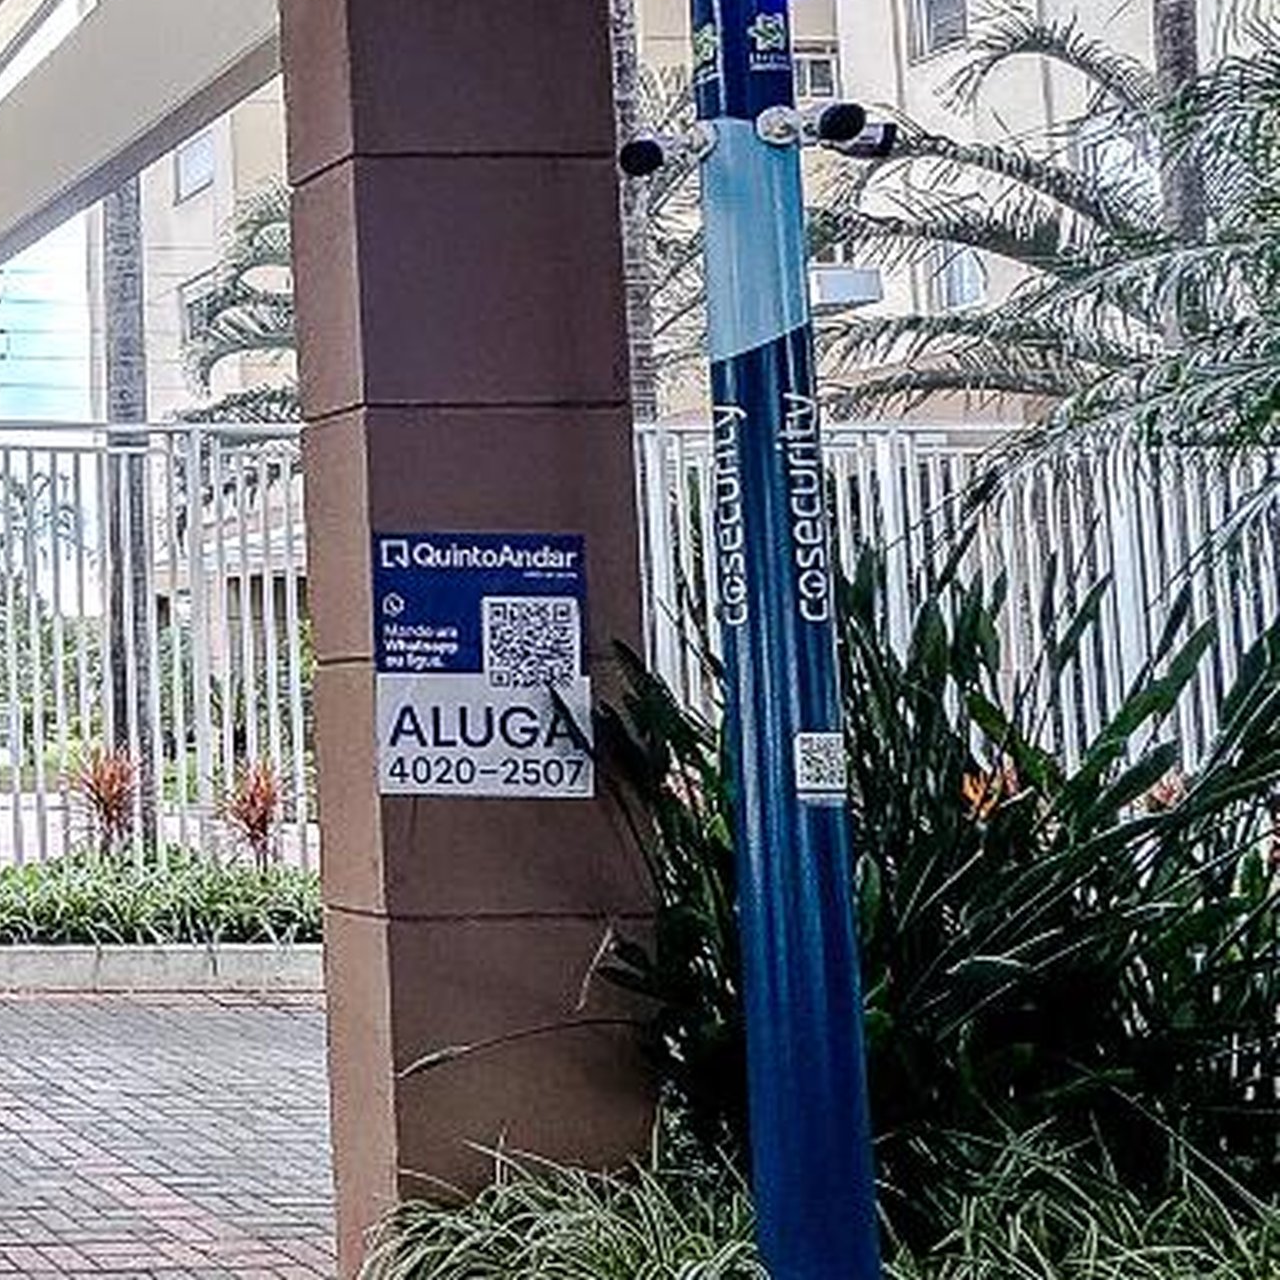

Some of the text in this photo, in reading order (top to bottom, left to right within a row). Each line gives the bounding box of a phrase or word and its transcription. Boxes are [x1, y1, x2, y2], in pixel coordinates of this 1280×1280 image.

[412, 542, 578, 569] QuintoAndar
[389, 705, 588, 749] ALUGA
[389, 757, 584, 786] 4020-2507
